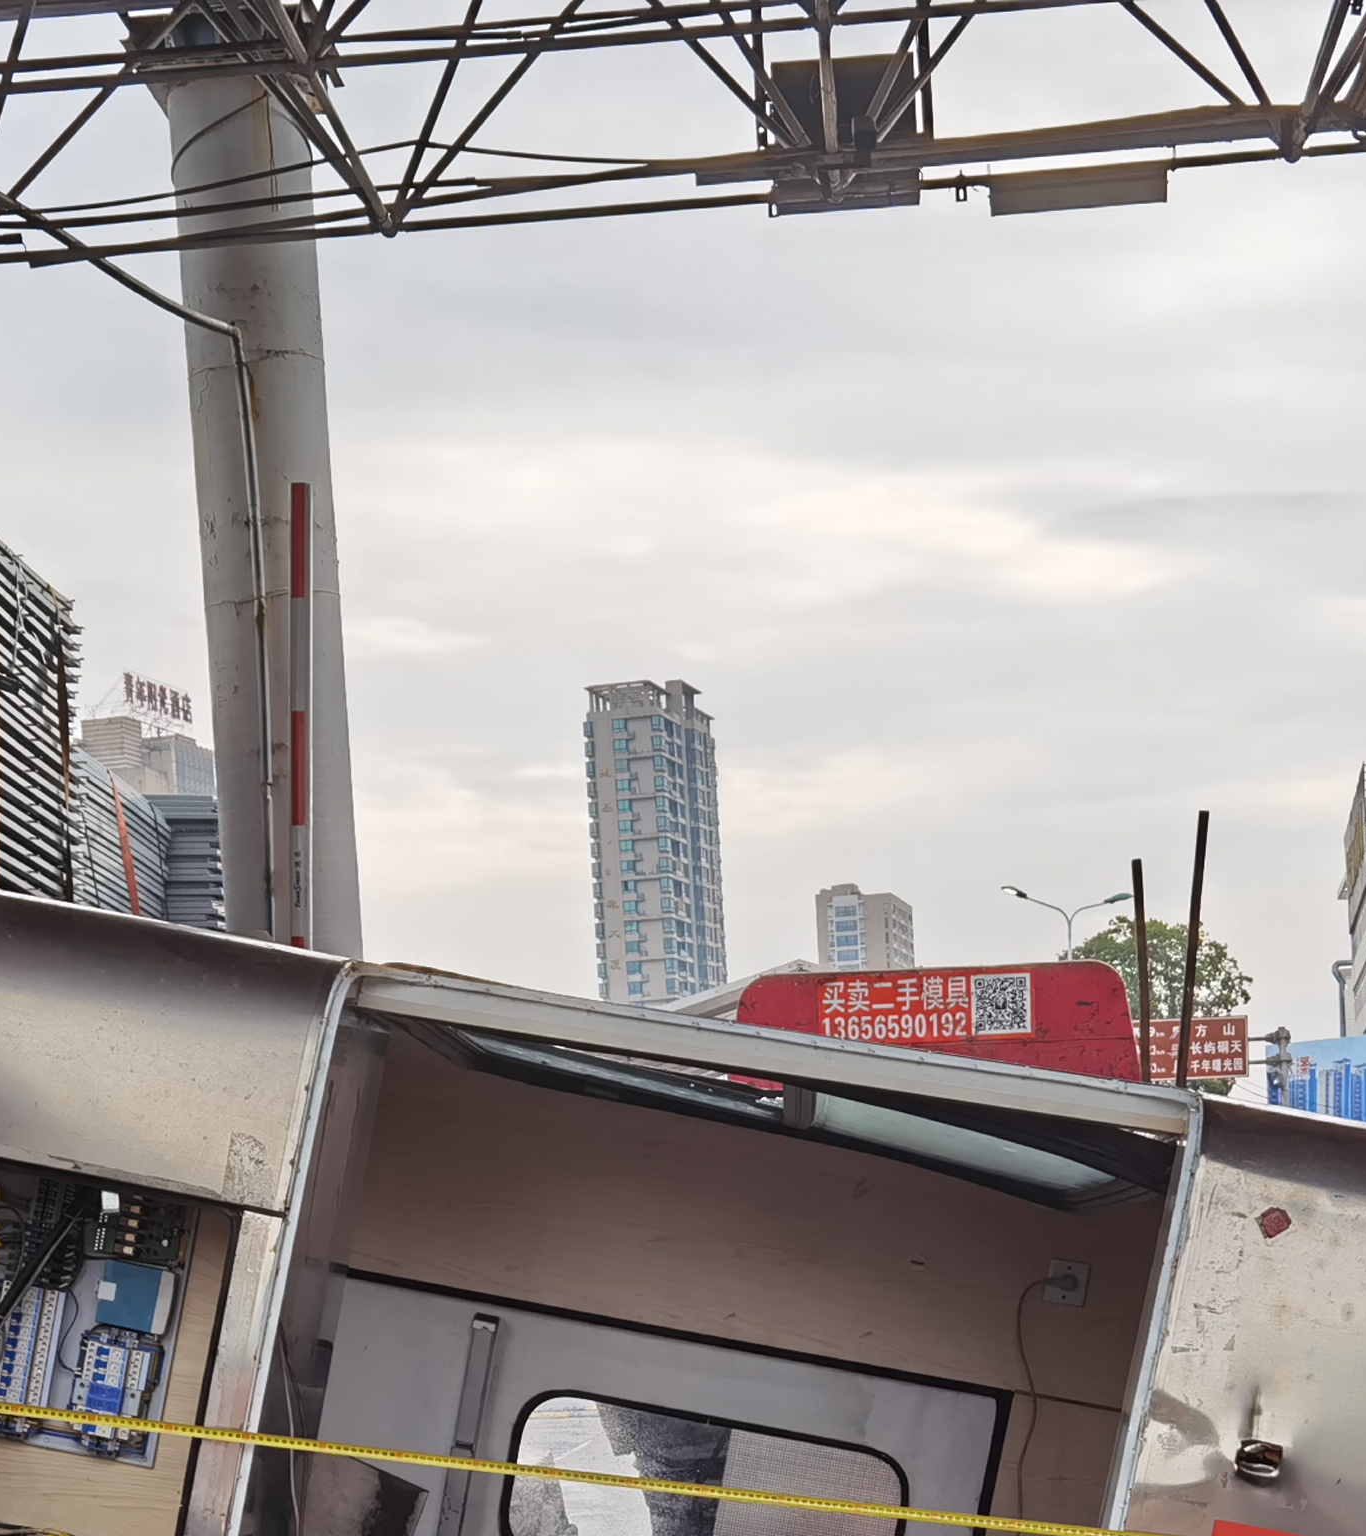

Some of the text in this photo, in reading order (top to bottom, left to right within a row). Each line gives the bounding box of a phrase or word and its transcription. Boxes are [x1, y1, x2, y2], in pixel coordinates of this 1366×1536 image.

[821, 975, 969, 1014] 买卖二手模具
[821, 1011, 968, 1041] 13656590192
